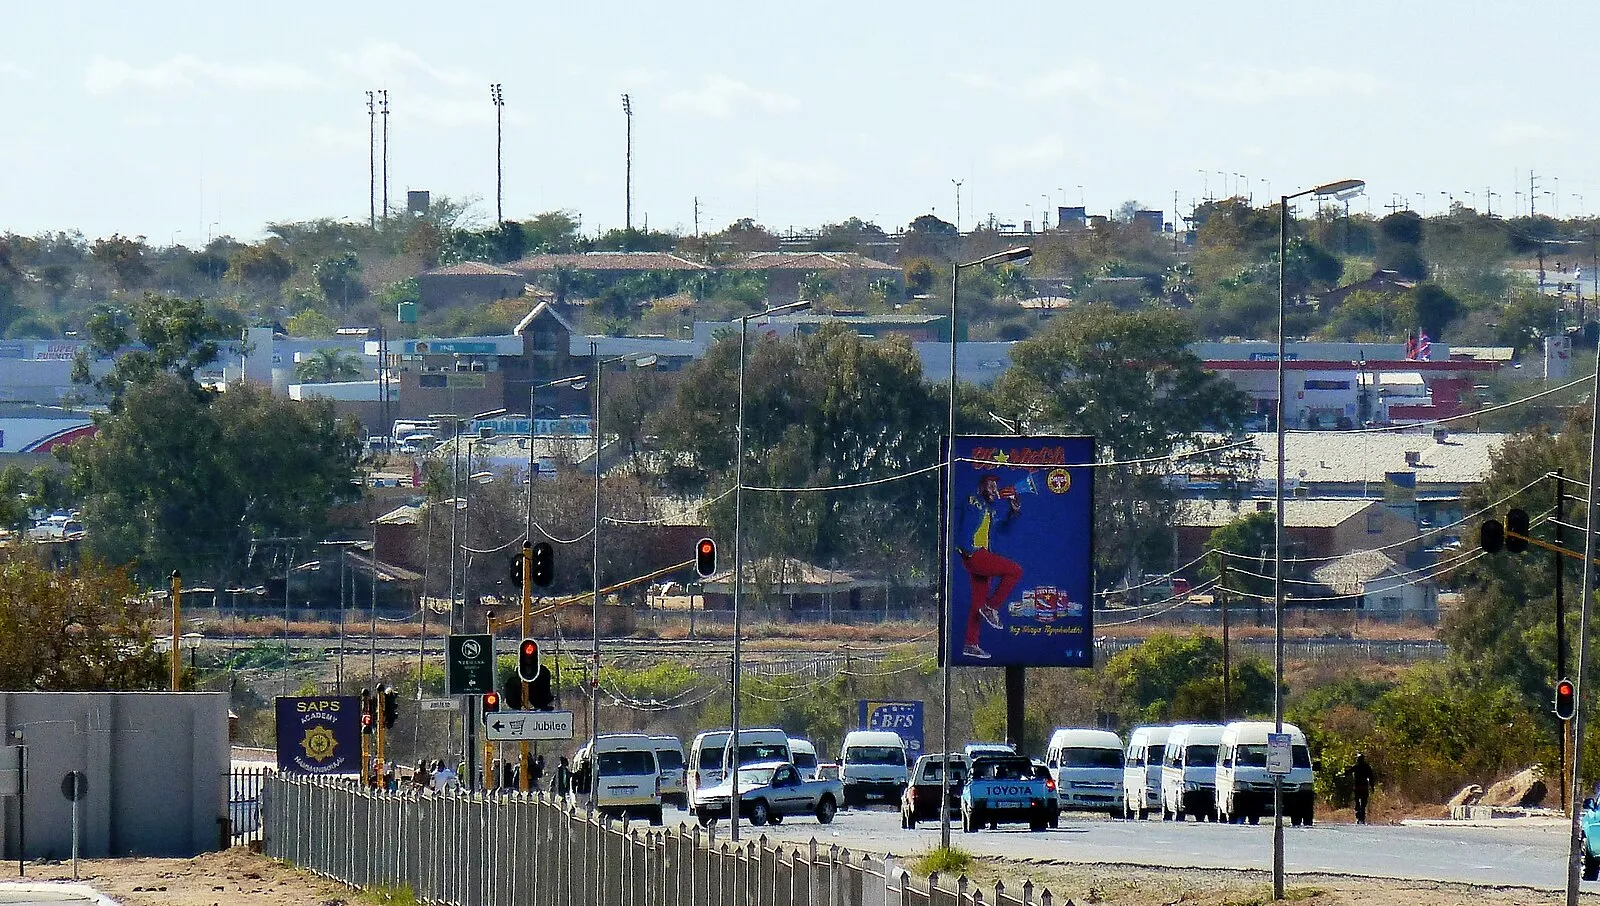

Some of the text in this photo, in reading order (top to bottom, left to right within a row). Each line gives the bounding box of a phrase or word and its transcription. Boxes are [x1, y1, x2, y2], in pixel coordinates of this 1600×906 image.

[296, 700, 341, 713] SAPS
[300, 711, 338, 725] ACADEMY
[881, 714, 915, 728] BFS
[532, 720, 567, 731] Jubilee
[985, 786, 1033, 796] TOYOTA
